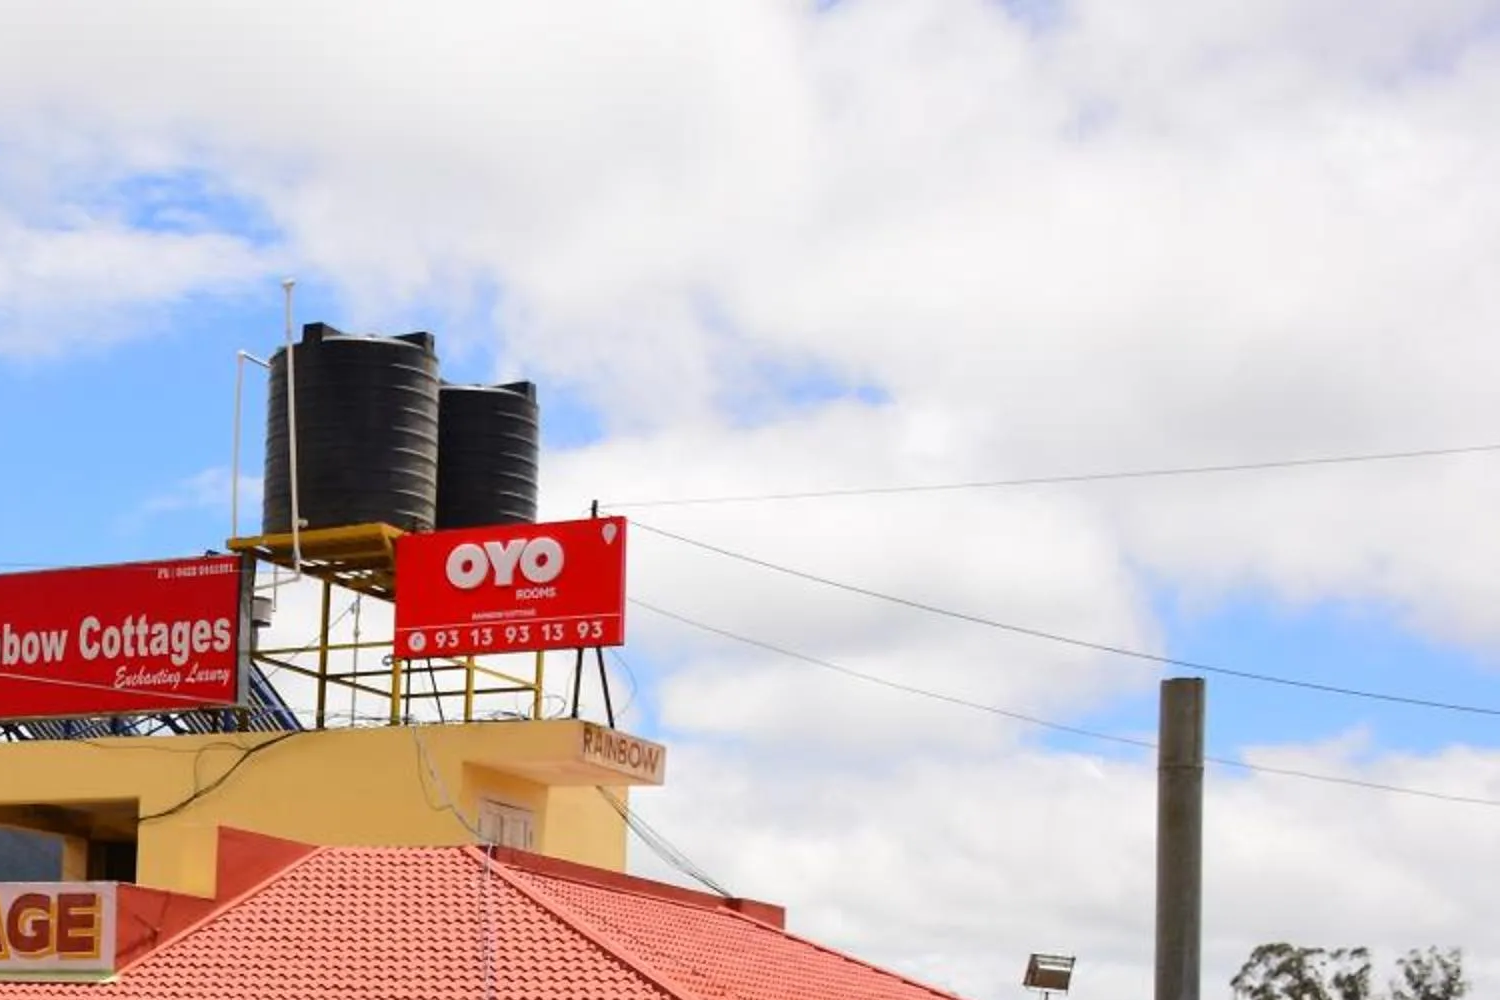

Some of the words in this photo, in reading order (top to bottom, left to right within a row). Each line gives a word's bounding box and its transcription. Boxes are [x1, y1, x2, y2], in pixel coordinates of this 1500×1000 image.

[445, 536, 565, 590] OYO
[515, 586, 557, 600] ROOMS
[78, 614, 232, 666] Cottages
[434, 630, 460, 648] 93
[470, 628, 493, 646] 13
[504, 626, 531, 644] 93
[541, 623, 564, 641] 13
[576, 621, 604, 639] 93
[114, 664, 181, 690] Enchanting
[184, 661, 231, 687] Luxury
[583, 725, 660, 774] RAINBOW
